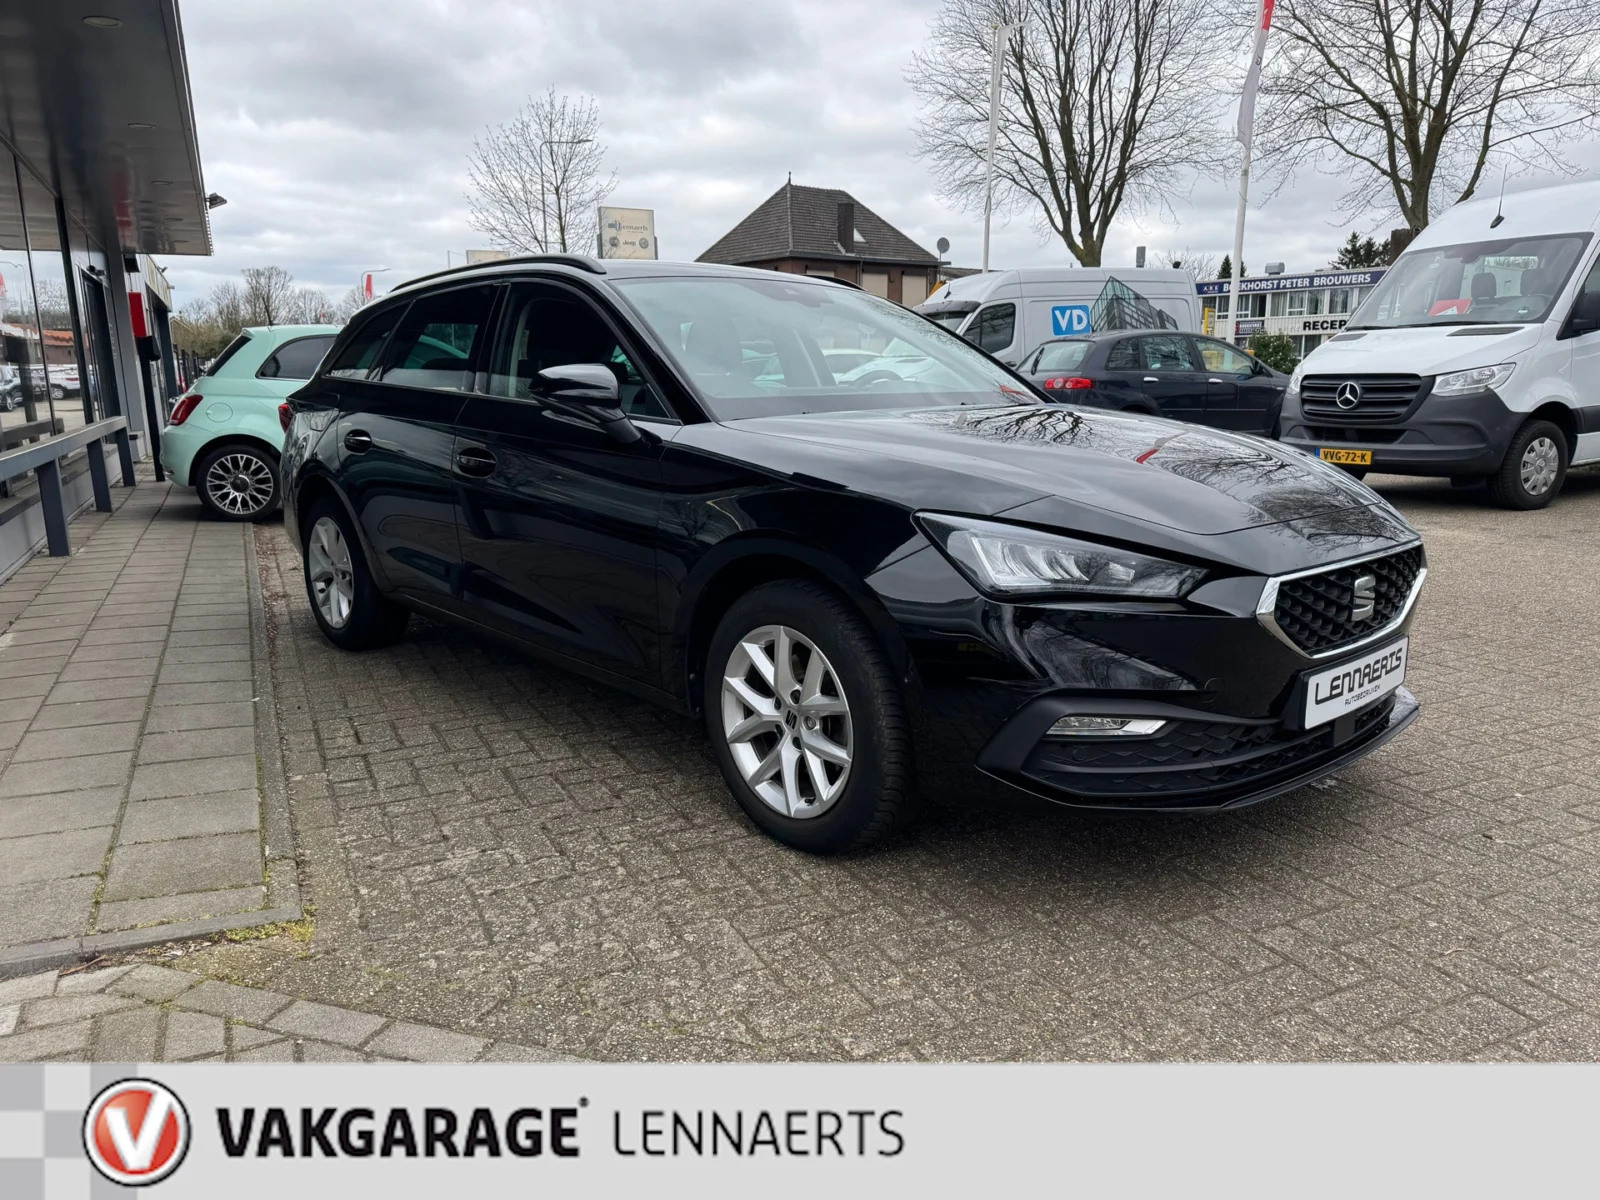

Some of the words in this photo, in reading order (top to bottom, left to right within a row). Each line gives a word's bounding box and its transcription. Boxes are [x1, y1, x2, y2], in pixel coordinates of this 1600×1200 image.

[1223, 280, 1279, 292] BKHORST
[1280, 278, 1310, 288] PETER
[1313, 274, 1371, 286] BROUWERS
[1054, 309, 1088, 332] VD
[1323, 450, 1367, 463] VVG-72-K
[1315, 647, 1403, 705] LENNAERTS
